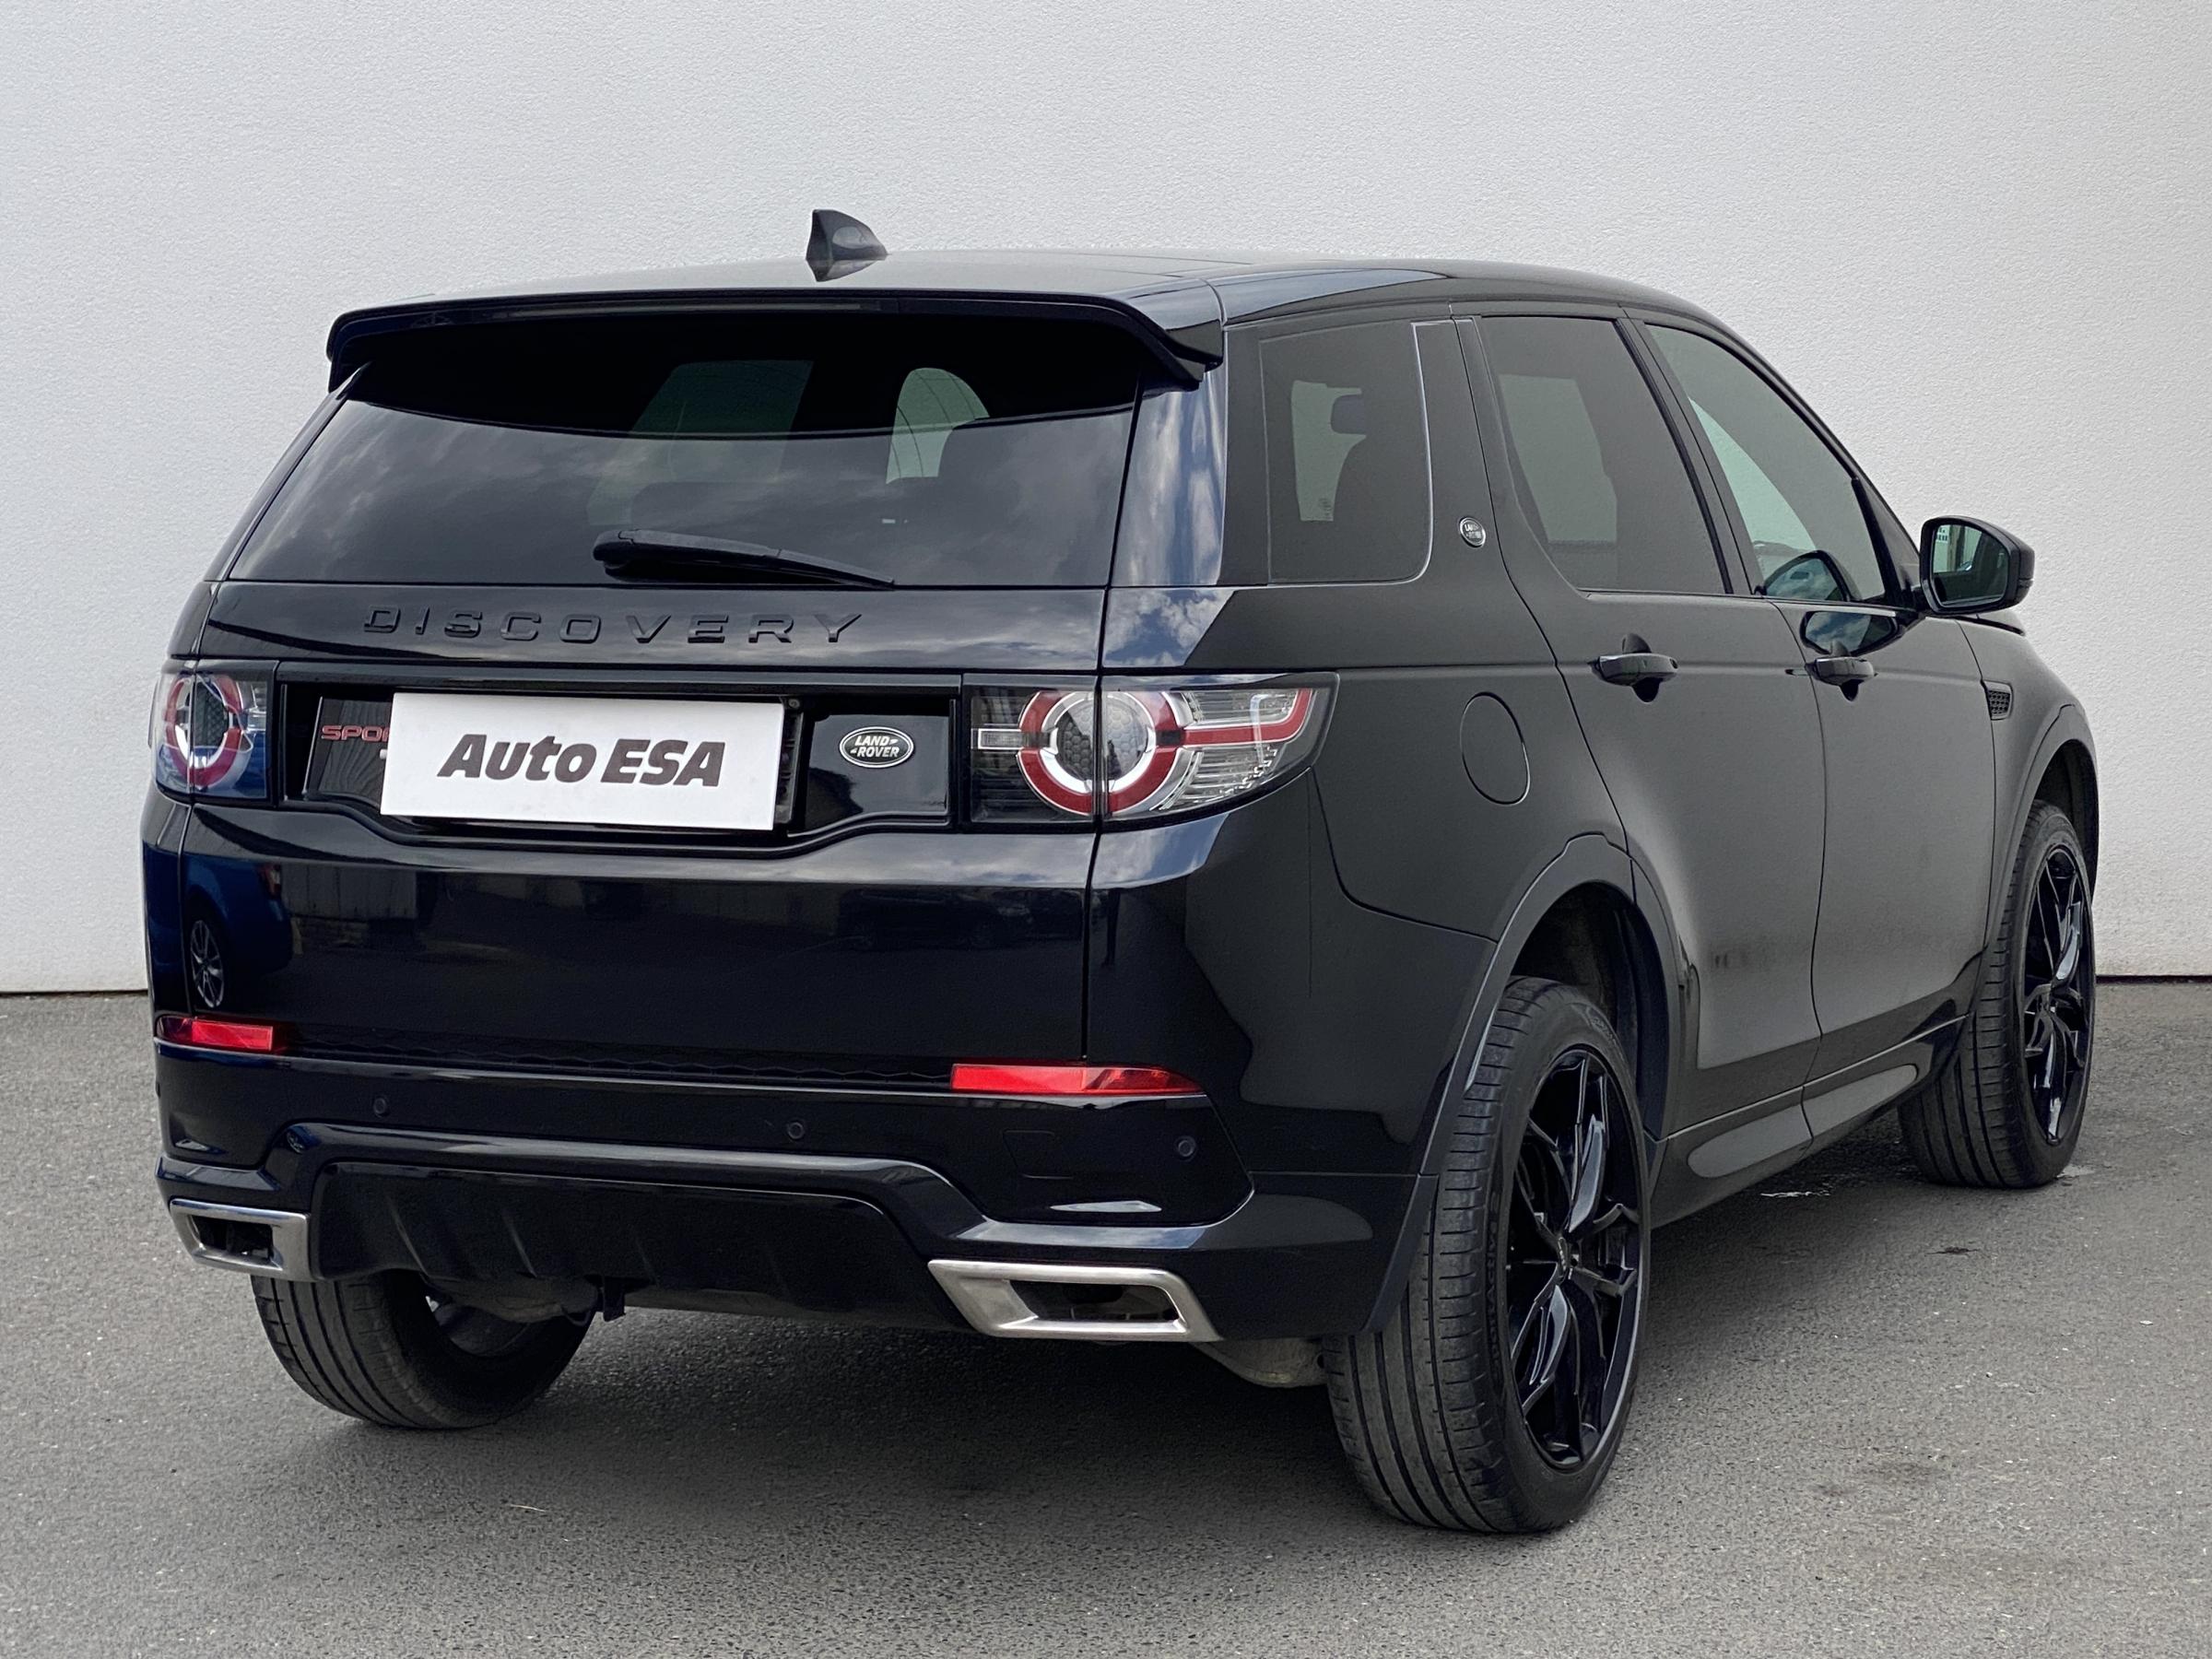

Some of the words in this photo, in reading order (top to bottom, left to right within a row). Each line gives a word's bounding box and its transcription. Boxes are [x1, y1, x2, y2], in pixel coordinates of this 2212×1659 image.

[364, 606, 862, 644] DISCOVERY
[854, 735, 890, 747] LAND
[856, 746, 900, 758] ROVER
[436, 734, 597, 782] Auto
[600, 738, 725, 786] ESA
